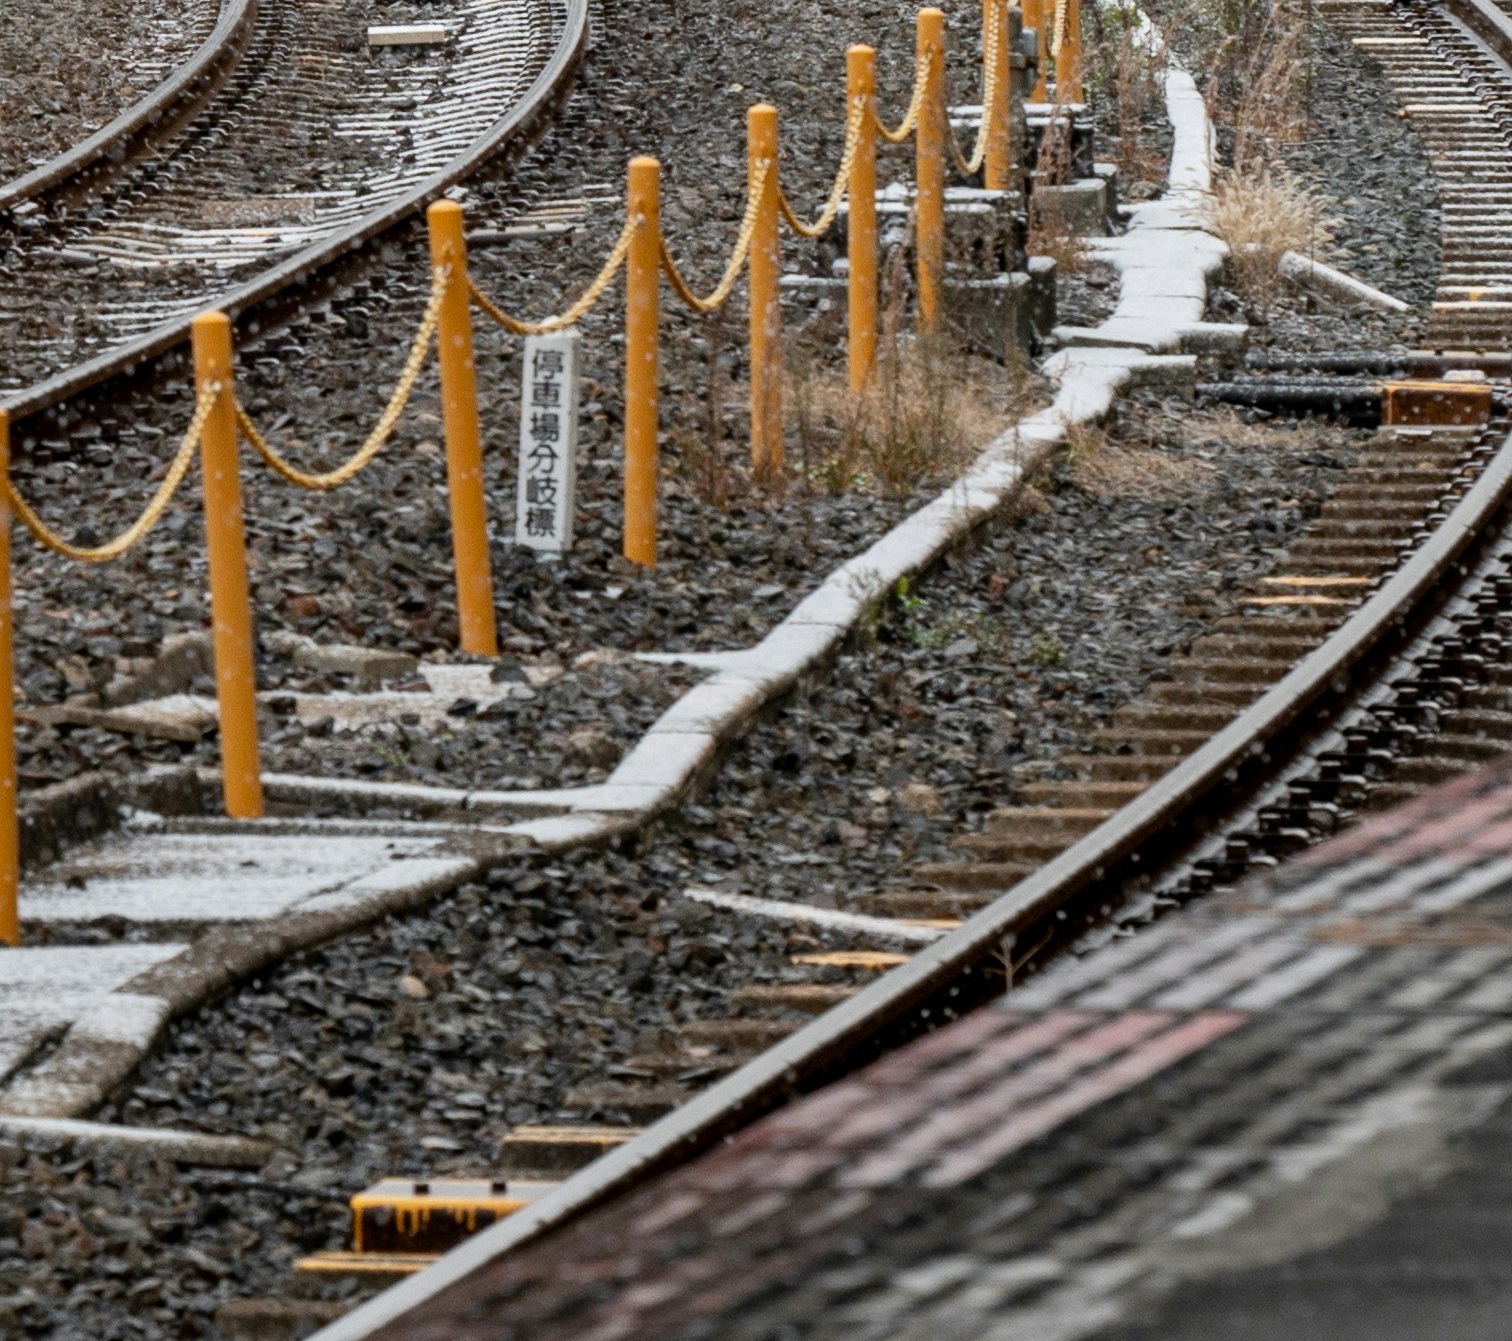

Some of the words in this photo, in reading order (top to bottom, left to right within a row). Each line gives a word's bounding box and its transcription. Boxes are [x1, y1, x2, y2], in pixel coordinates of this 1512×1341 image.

[524, 348, 565, 539] 停車場分岐標
